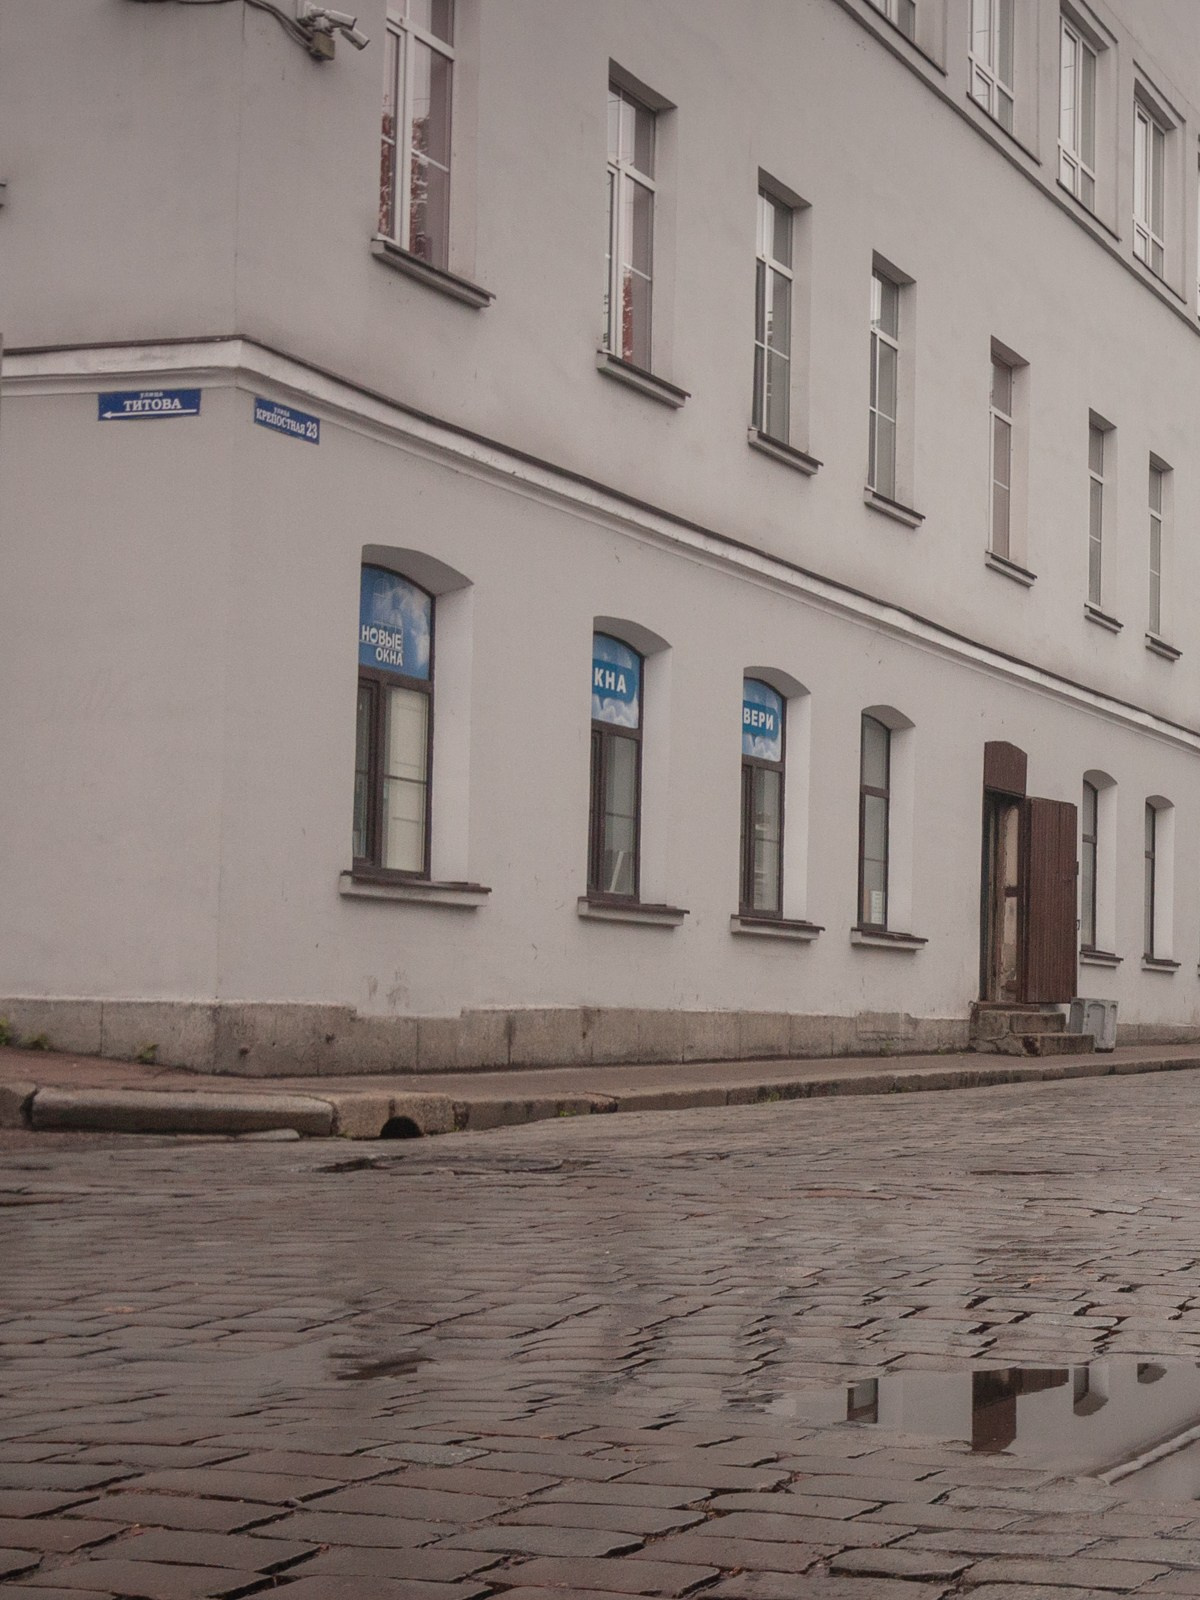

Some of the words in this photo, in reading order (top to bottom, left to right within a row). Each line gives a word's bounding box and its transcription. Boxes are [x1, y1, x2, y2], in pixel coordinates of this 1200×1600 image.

[123, 398, 182, 412] ТИТОВА
[256, 408, 306, 435] КРЕПОСТНАЯ
[306, 421, 318, 439] 23
[361, 624, 402, 650] НОВЫЕ
[375, 647, 404, 667] ОКНА
[594, 667, 627, 694] КНА
[743, 707, 774, 731] ВЕРИ
